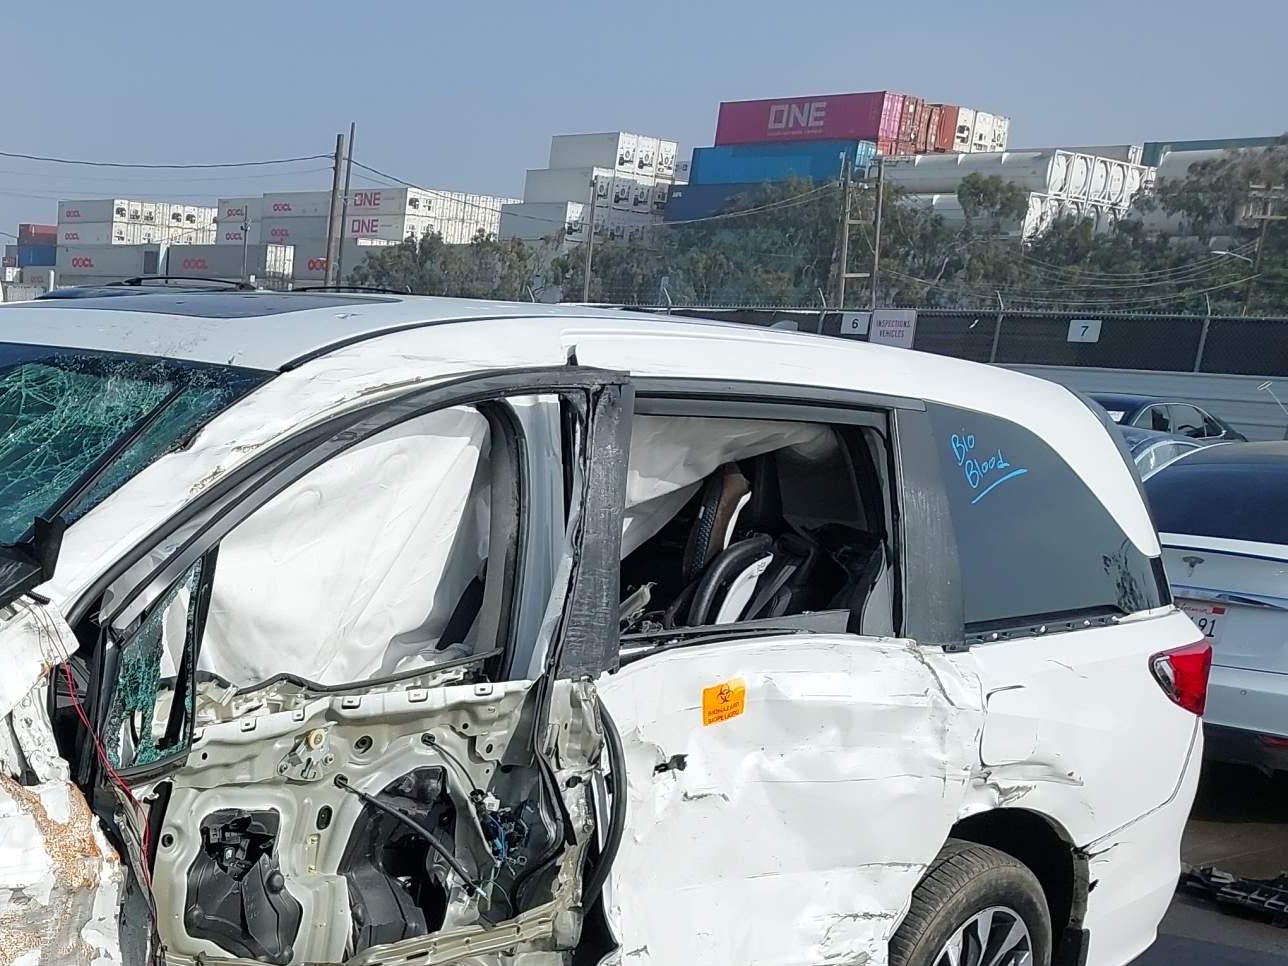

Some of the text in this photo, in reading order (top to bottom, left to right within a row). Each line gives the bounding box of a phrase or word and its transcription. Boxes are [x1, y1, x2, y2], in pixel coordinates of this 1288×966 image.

[768, 102, 828, 129] ONE
[354, 191, 381, 207] ONE
[272, 203, 292, 212] OOCL
[351, 219, 379, 233] ONE
[72, 256, 94, 269] OOCL
[183, 258, 208, 270] OOCL
[307, 257, 328, 271] OOC
[852, 318, 859, 329] 6
[1080, 325, 1089, 337] 7
[965, 447, 1010, 489] Blood
